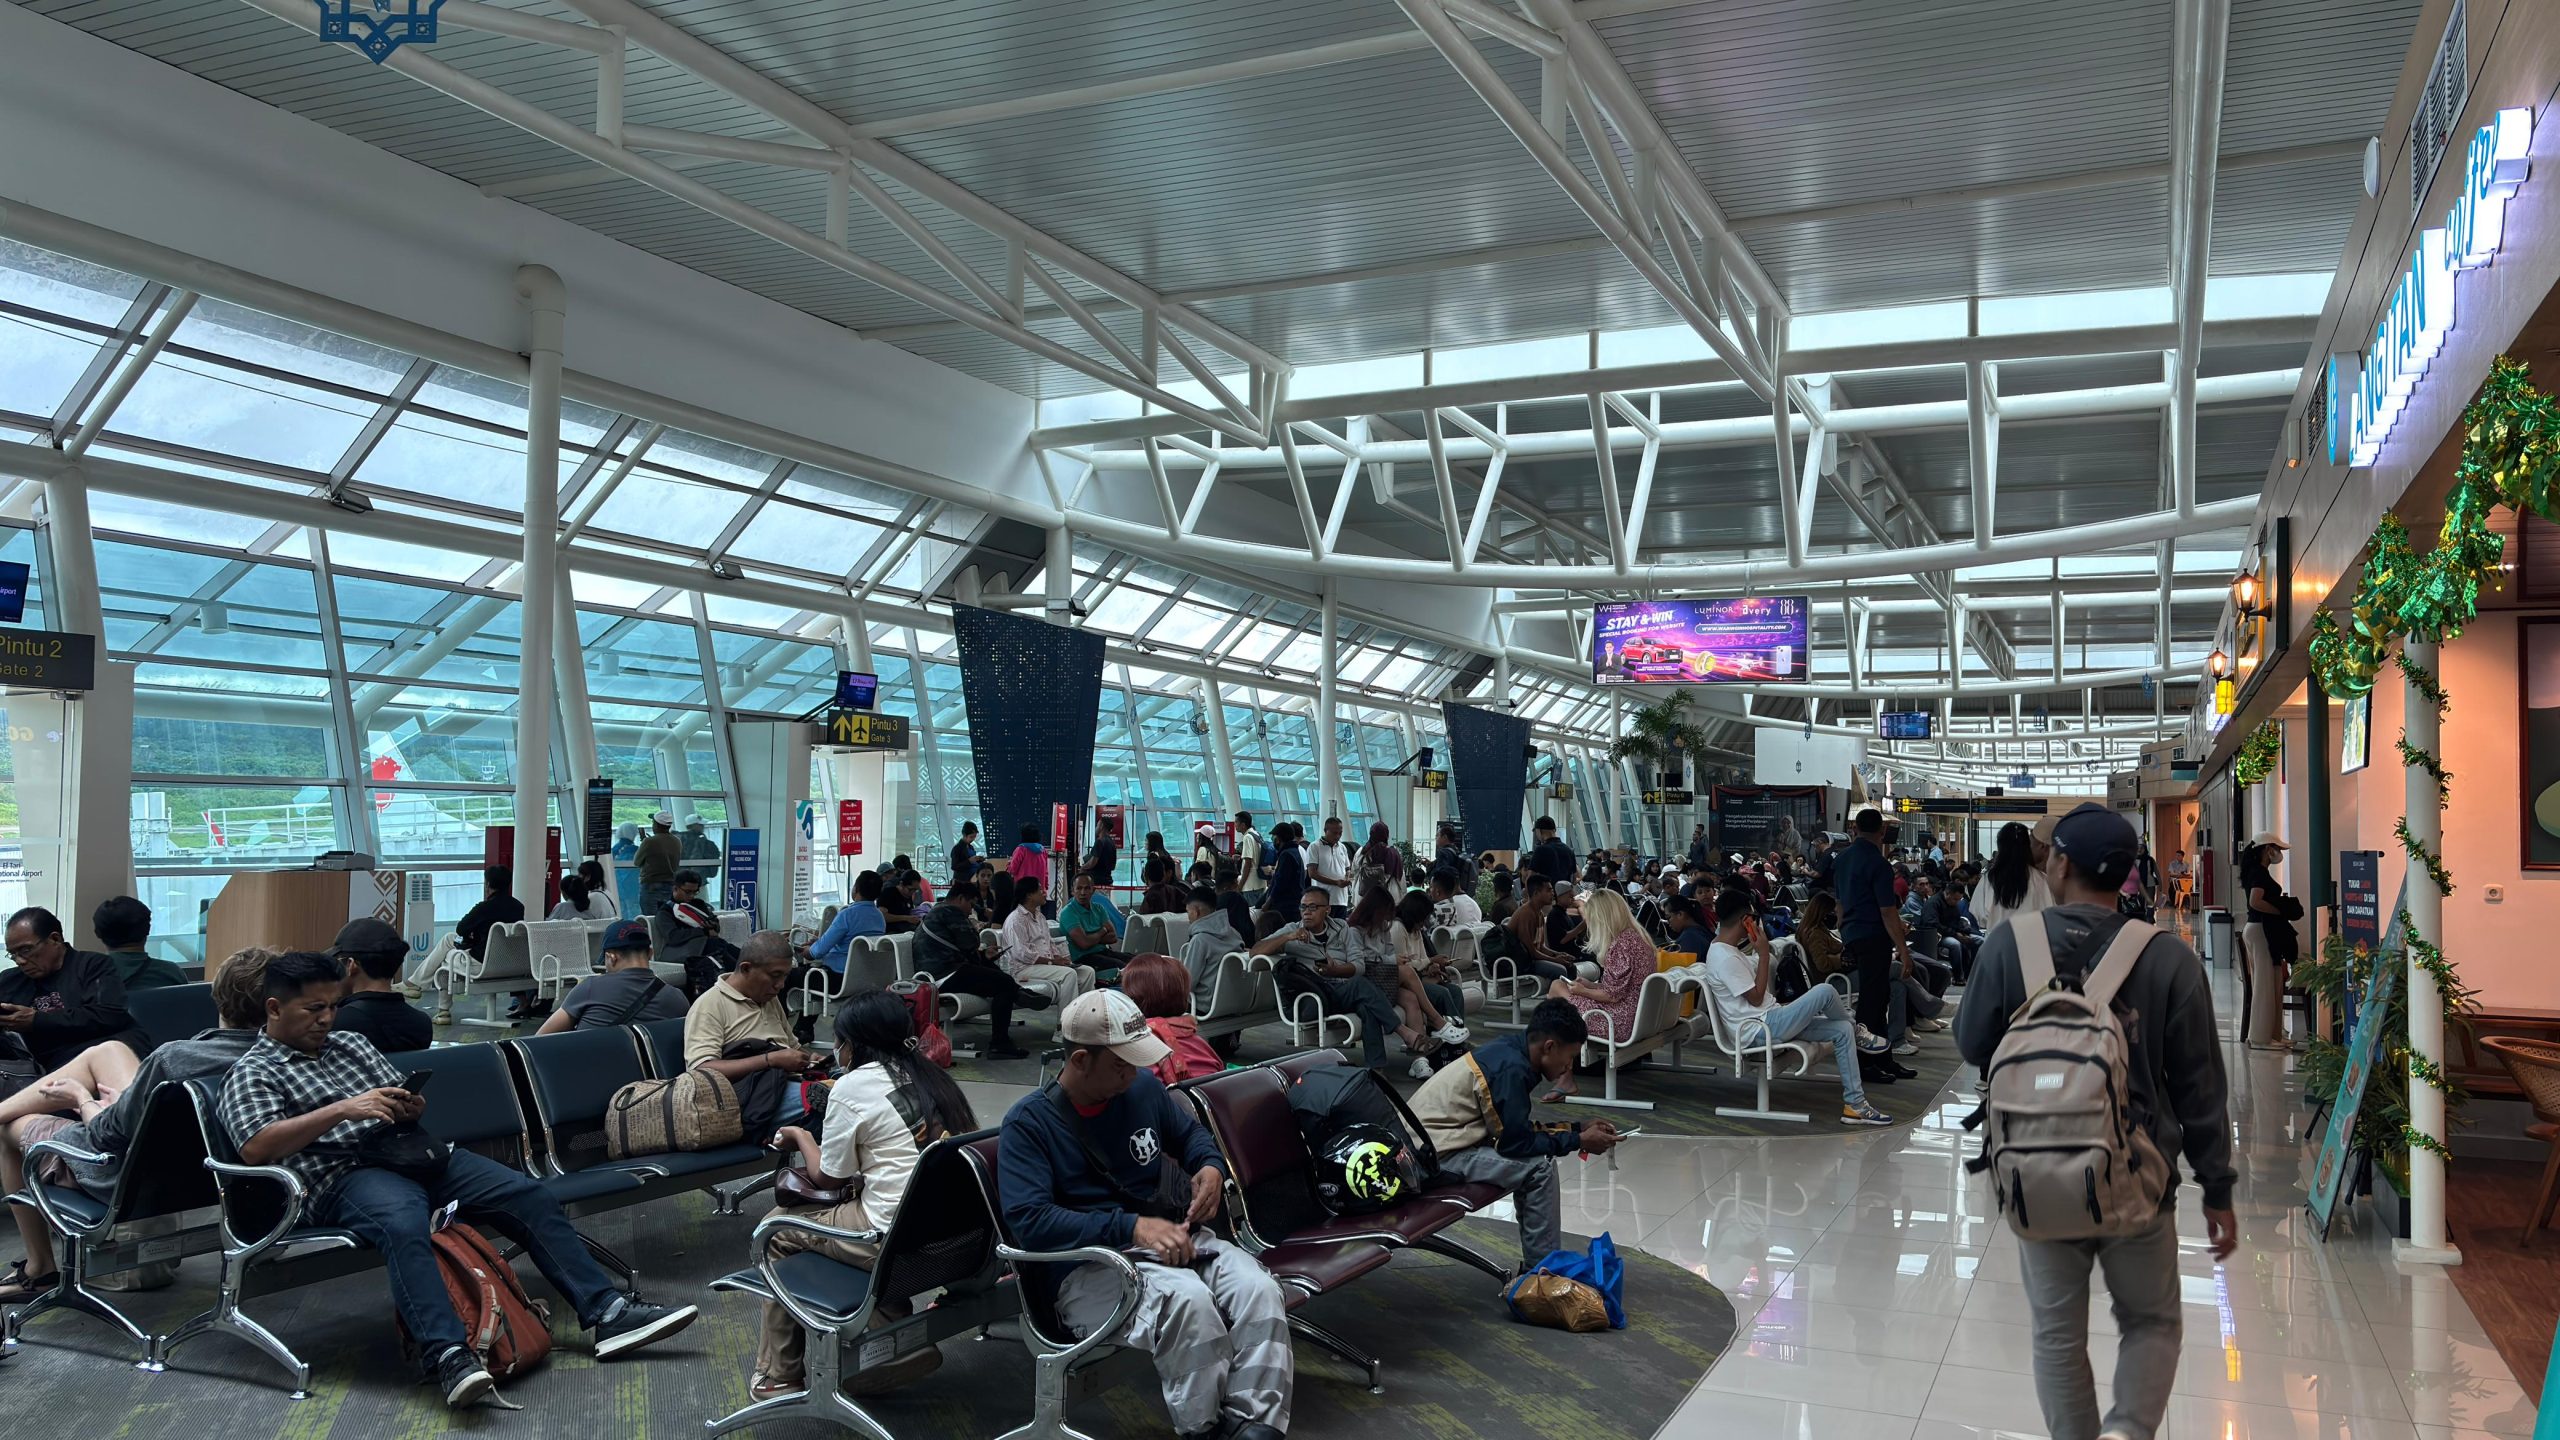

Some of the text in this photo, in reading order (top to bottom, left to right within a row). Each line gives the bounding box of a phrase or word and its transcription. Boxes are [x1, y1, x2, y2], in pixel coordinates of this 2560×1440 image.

[2348, 229, 2430, 466] ANGITAN
[0, 586, 17, 596] irport
[1694, 604, 1734, 614] LUMINOR
[1606, 610, 1675, 630] STAY & WIN
[1622, 627, 1648, 635] BOOKING
[1661, 622, 1686, 630] WEBSITE
[49, 639, 62, 658] 2
[0, 663, 43, 678] ate 2
[871, 717, 898, 731] Pintu 3
[871, 733, 891, 743] Gate 3
[21, 869, 43, 878] Airport
